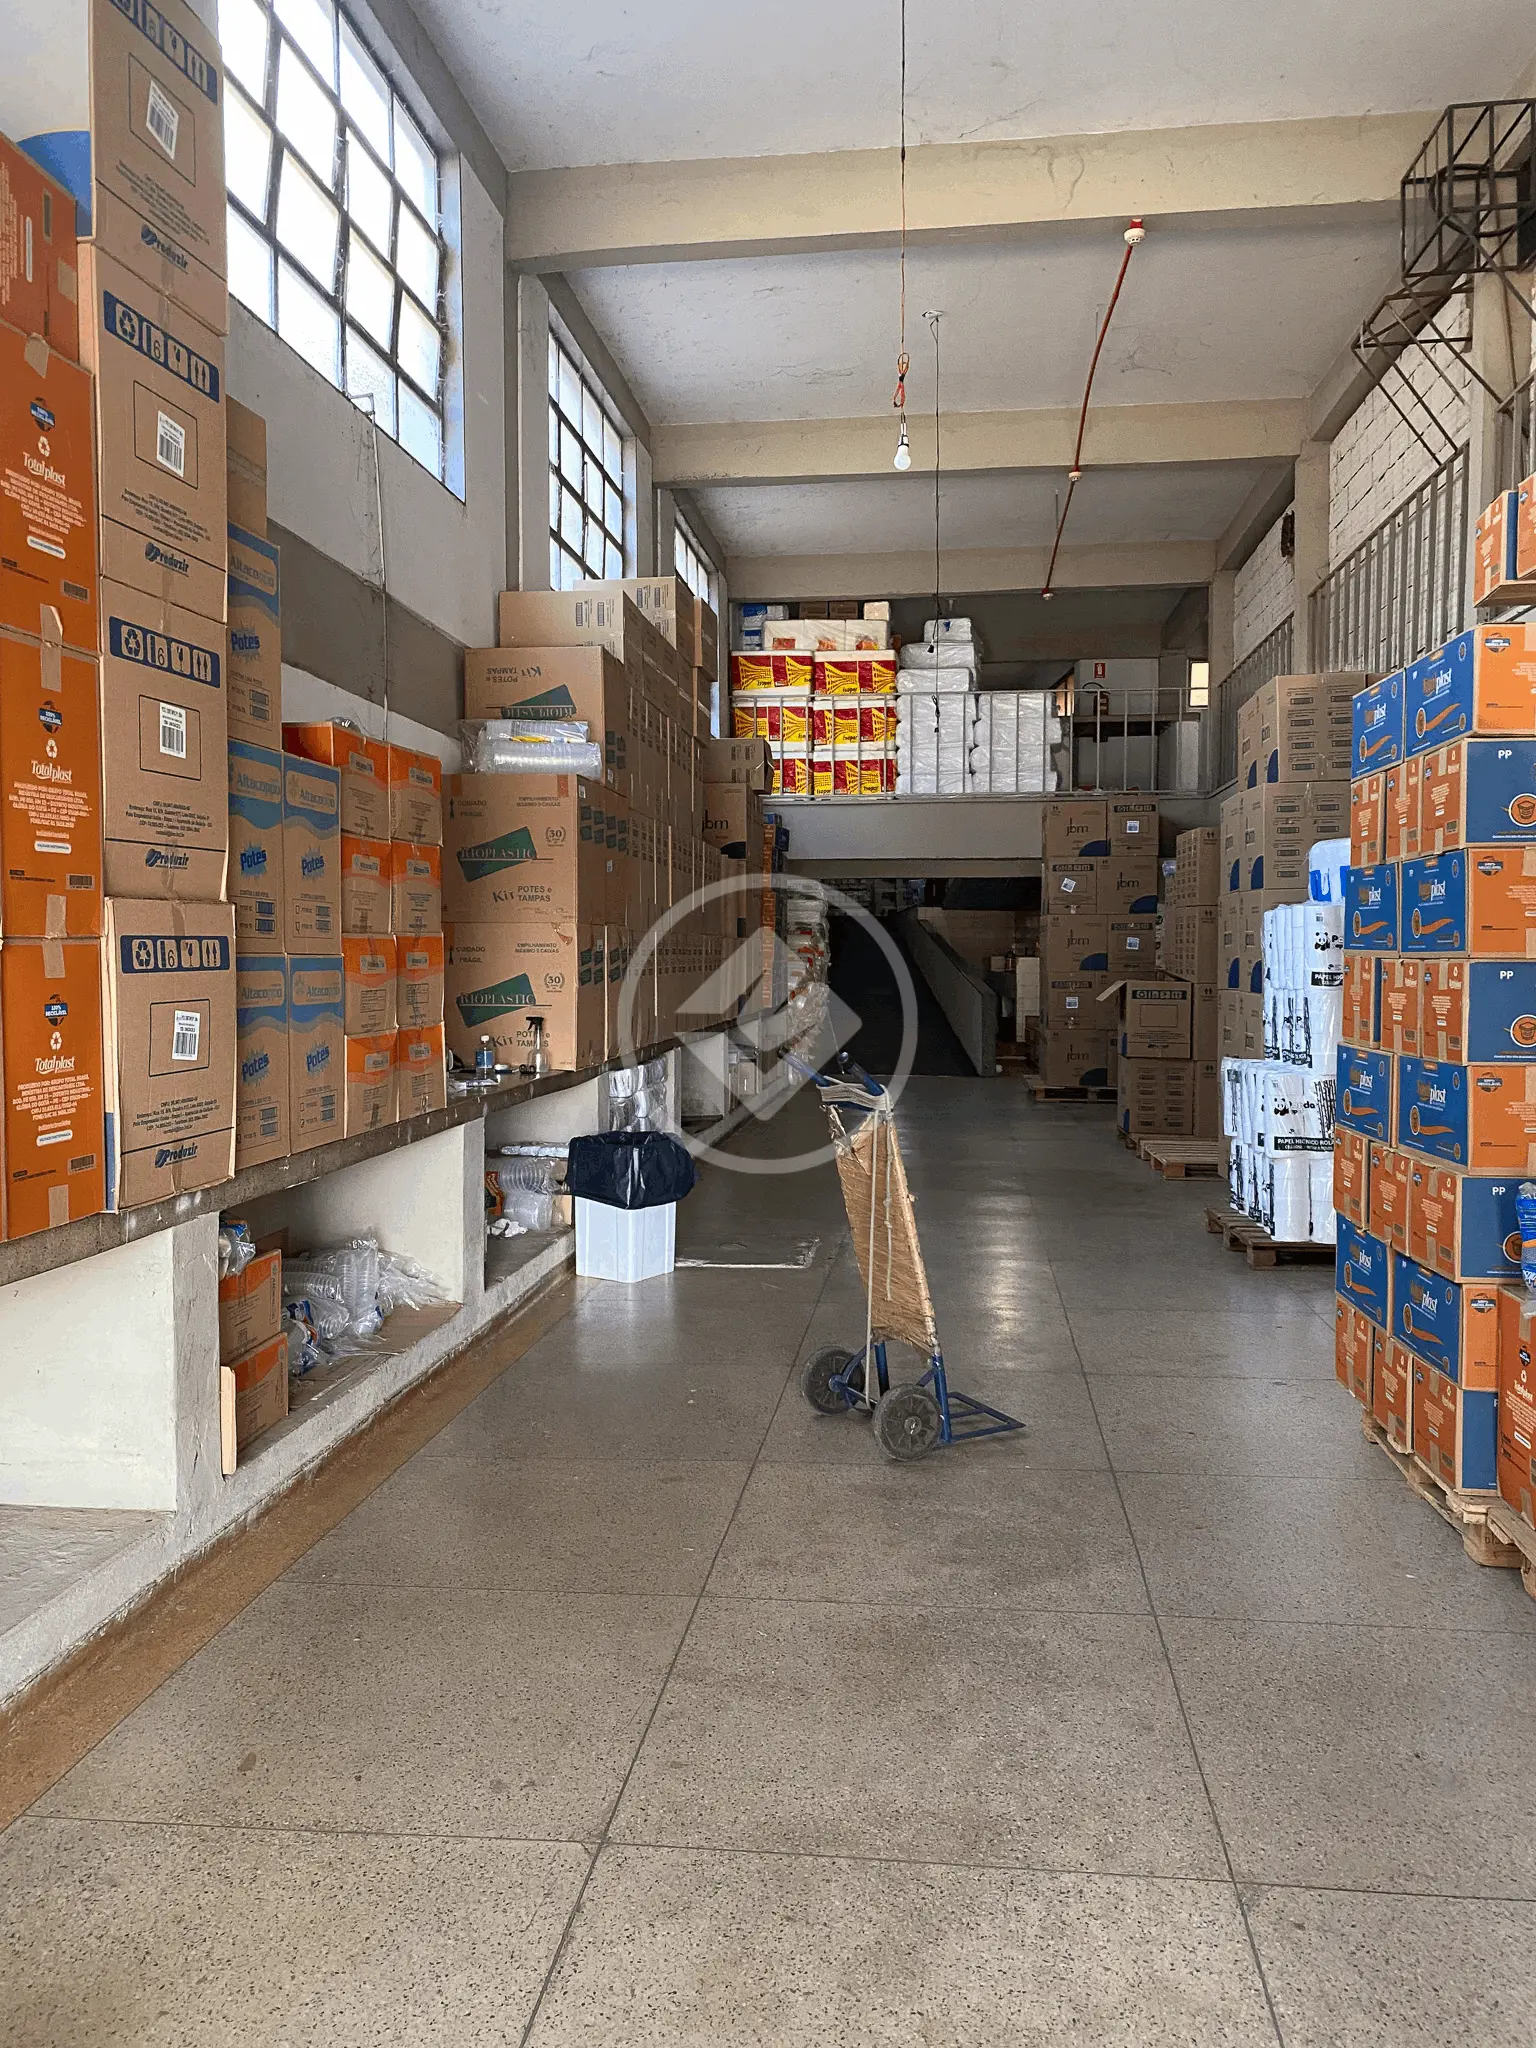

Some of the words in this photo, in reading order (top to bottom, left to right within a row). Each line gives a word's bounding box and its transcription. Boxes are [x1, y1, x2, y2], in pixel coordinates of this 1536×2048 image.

[231, 630, 260, 651] Potes
[157, 647, 165, 666] 6
[1498, 750, 1512, 759] PP
[31, 760, 72, 783] Totalplast
[702, 809, 728, 832] jbm
[1066, 817, 1089, 837] jbm
[549, 829, 562, 838] 30
[155, 849, 189, 867] Produzir
[240, 849, 267, 871] Potes
[301, 855, 325, 876] Potes
[517, 885, 545, 893] POTES
[1116, 871, 1140, 891] jbm
[517, 894, 551, 902] TAMPAS
[1067, 929, 1090, 949] jbm
[168, 949, 175, 967] 6
[547, 976, 561, 984] 30
[1500, 970, 1514, 980] PP
[306, 1046, 330, 1072] Potes
[1066, 1043, 1090, 1063] jbm
[34, 1055, 75, 1074] Totalplast
[242, 1053, 270, 1081] Potes
[162, 1142, 198, 1163] Produzir
[1492, 1186, 1506, 1196] PP
